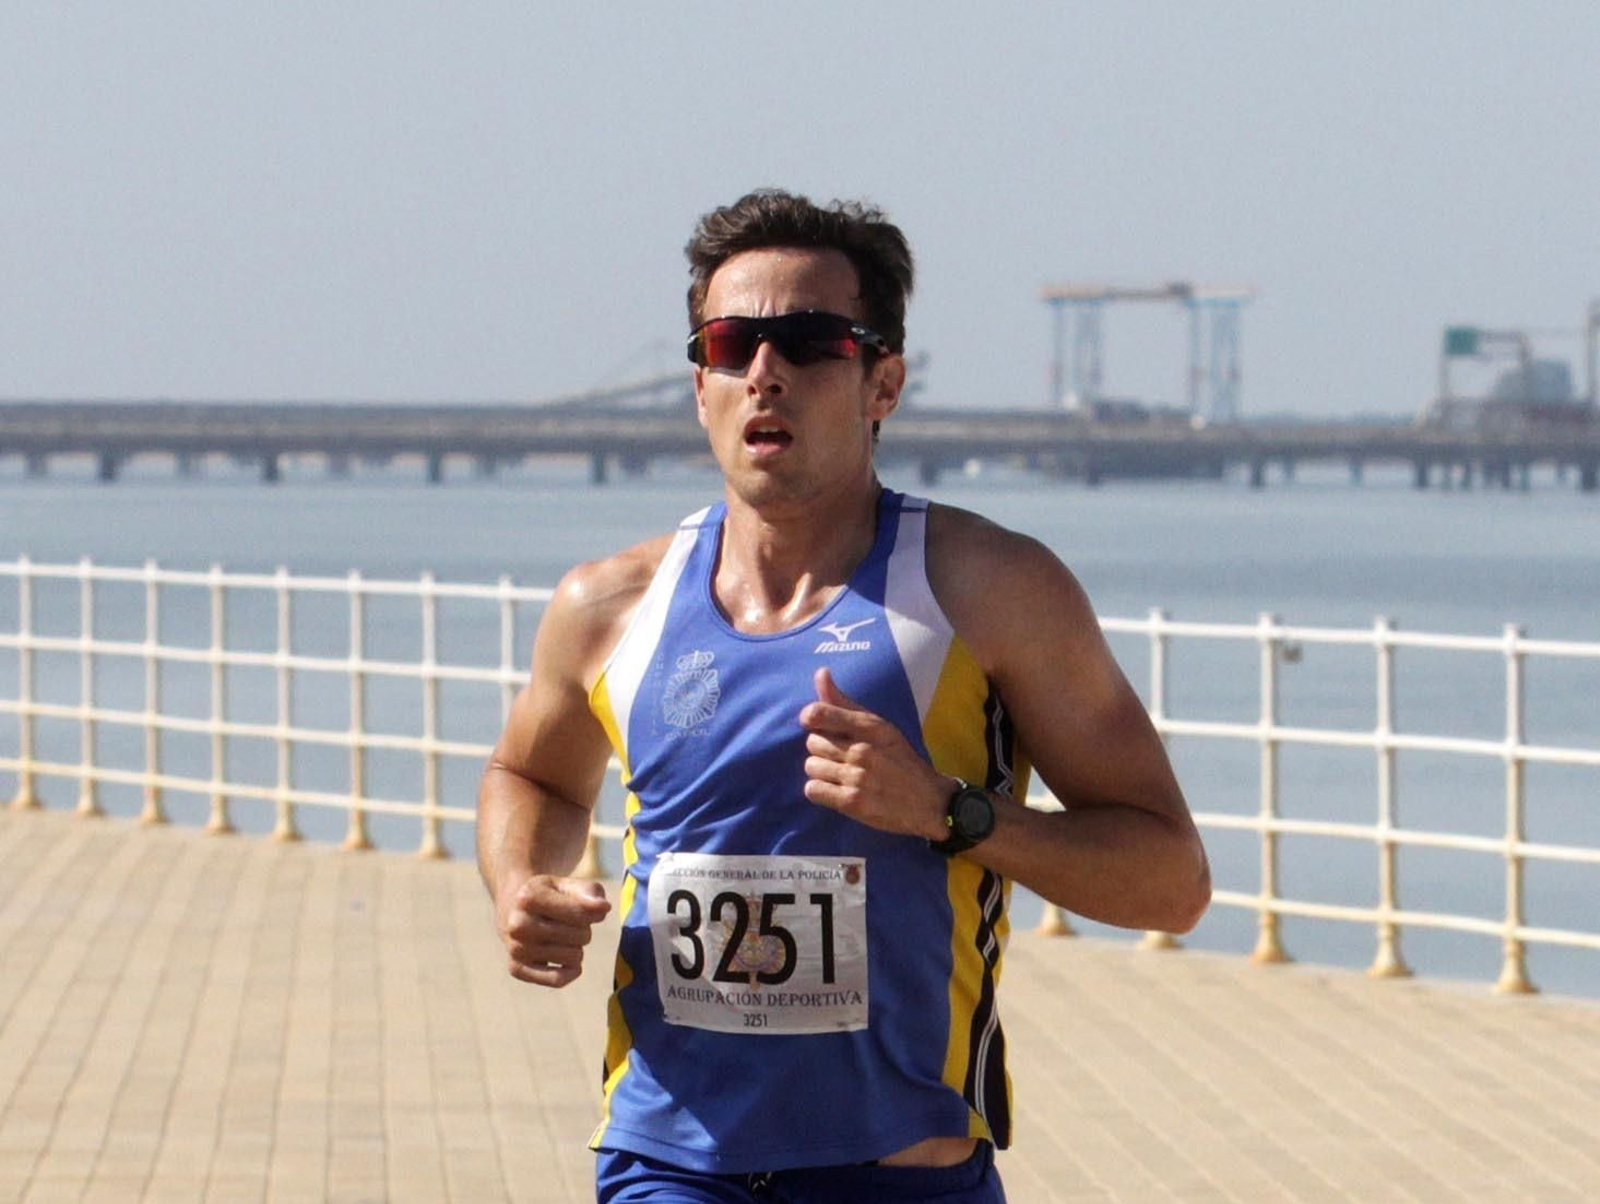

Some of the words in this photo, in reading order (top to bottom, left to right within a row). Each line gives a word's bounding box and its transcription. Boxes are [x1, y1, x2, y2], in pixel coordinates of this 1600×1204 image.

[708, 869, 757, 881] GENERAL
[762, 870, 775, 880] DE
[780, 870, 794, 880] LA
[667, 889, 836, 985] 3251
[667, 985, 762, 1006] AGRUPACIÓN
[767, 989, 862, 1007] DEPORTIVA
[743, 1013, 768, 1027] 3251
